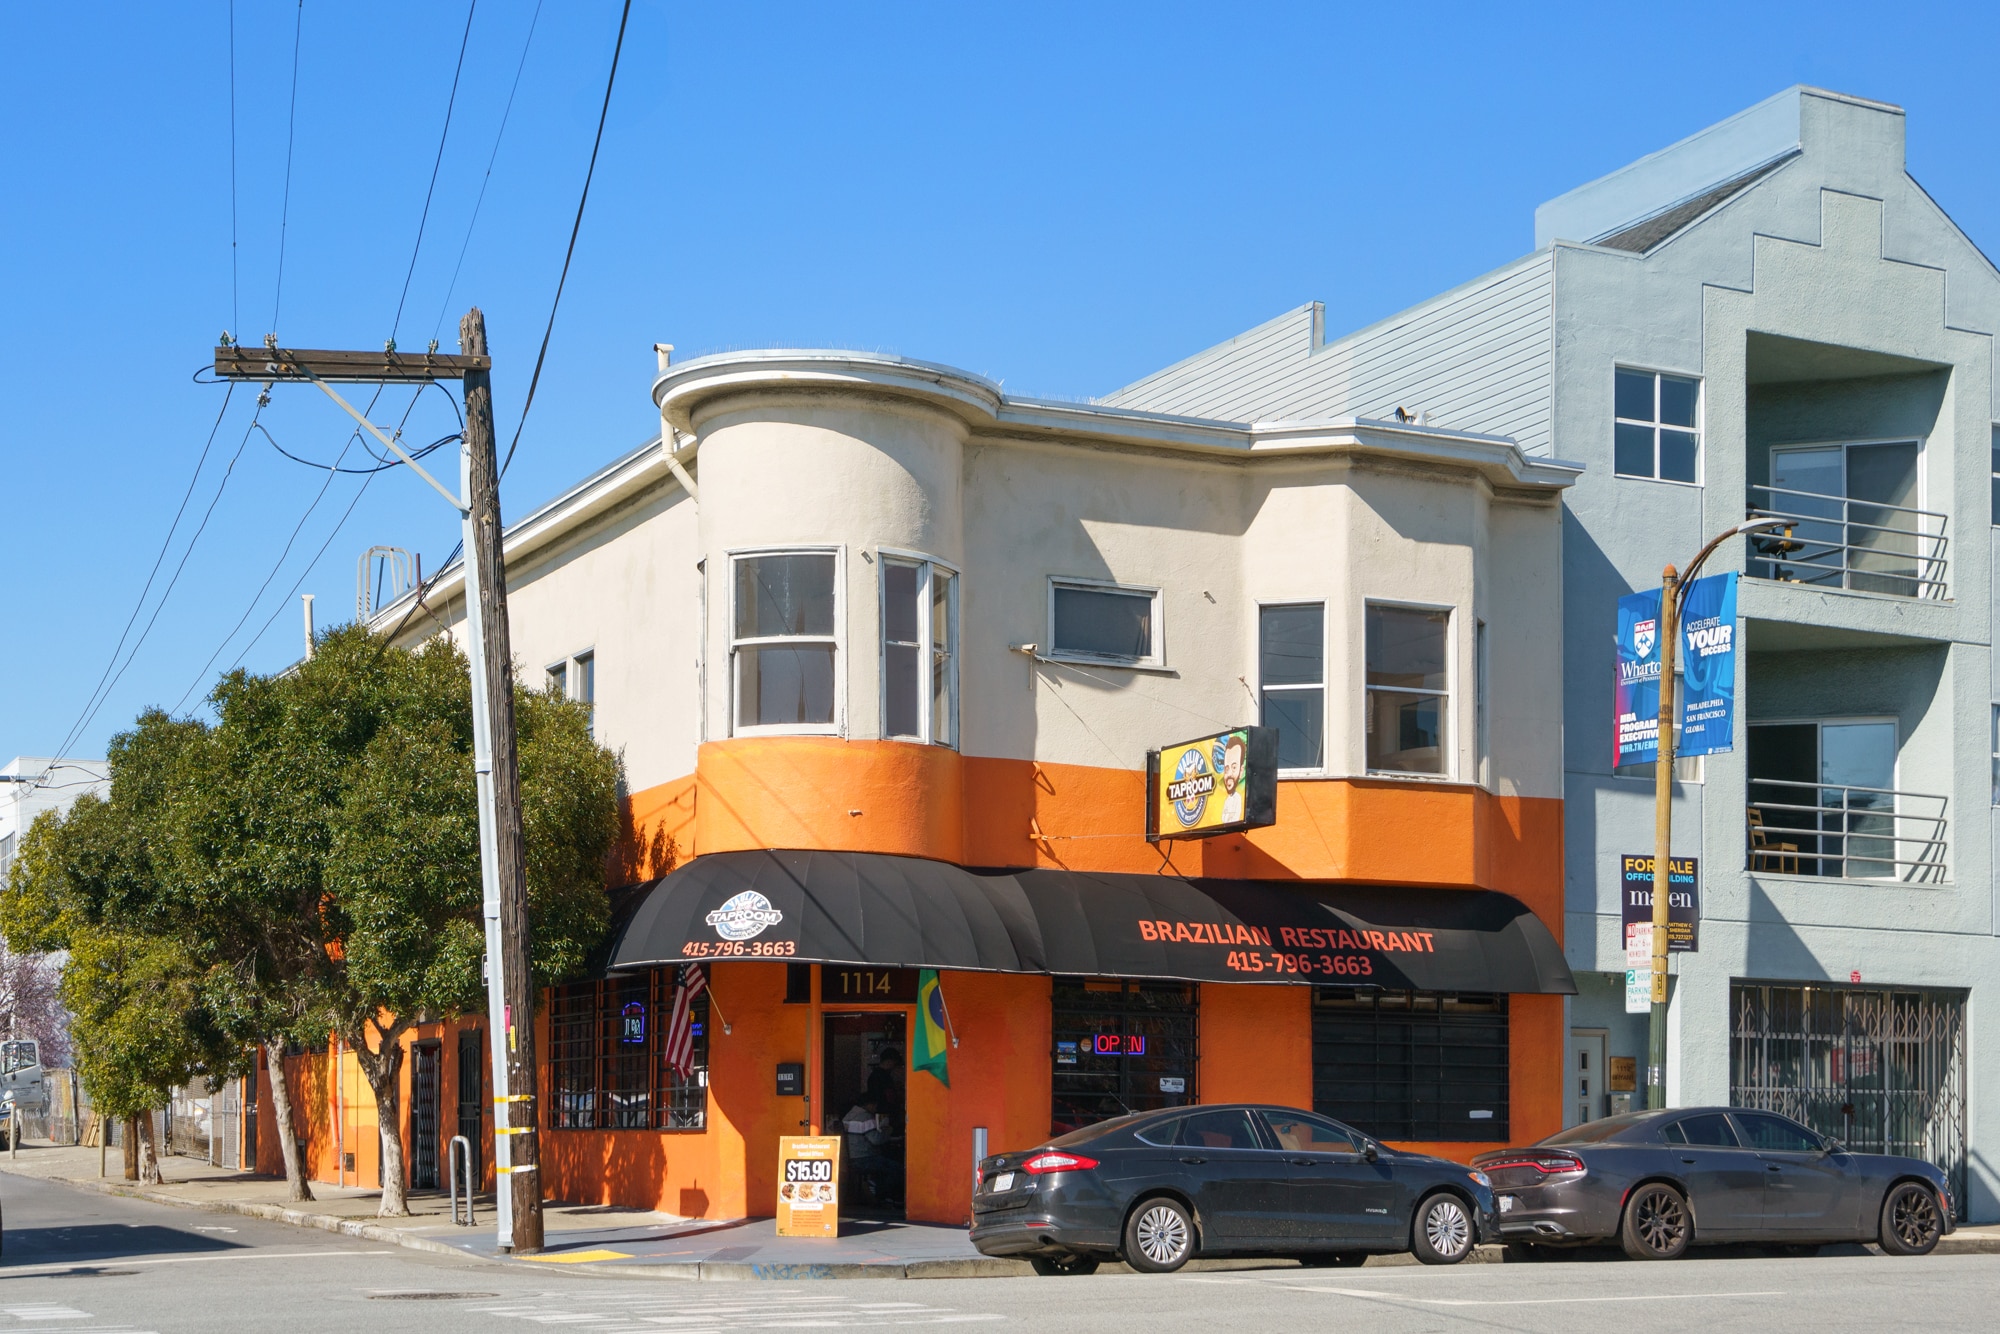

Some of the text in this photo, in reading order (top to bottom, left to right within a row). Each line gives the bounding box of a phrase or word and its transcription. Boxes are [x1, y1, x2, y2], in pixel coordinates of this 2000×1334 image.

[1686, 616, 1720, 632] ACCELERATE
[1687, 625, 1732, 650] YOUR
[1700, 643, 1731, 657] SUCCESS
[1621, 660, 1661, 678] Wharto
[1687, 699, 1724, 712] PHILADELPHIA
[1620, 712, 1636, 723] MBA
[1686, 709, 1726, 723] SAN FRANCISCO
[1620, 719, 1658, 733] PROGRAM
[1685, 724, 1705, 734] GLOBAL
[1620, 729, 1659, 743] EXECUTIV
[1169, 776, 1213, 799] TAPROOM
[1625, 858, 1694, 874] FOR ALE
[1629, 890, 1692, 908] maen
[712, 910, 777, 922] TAPROOM
[1138, 920, 1434, 953] BRAZILIAN RESTAURANT
[682, 940, 796, 957] 415-796-3663
[1226, 951, 1373, 976] 415-796-3663
[840, 972, 891, 994] 1114
[1628, 970, 1635, 984] 2
[1097, 1035, 1142, 1052] OPN
[787, 1160, 830, 1181] $15.90
